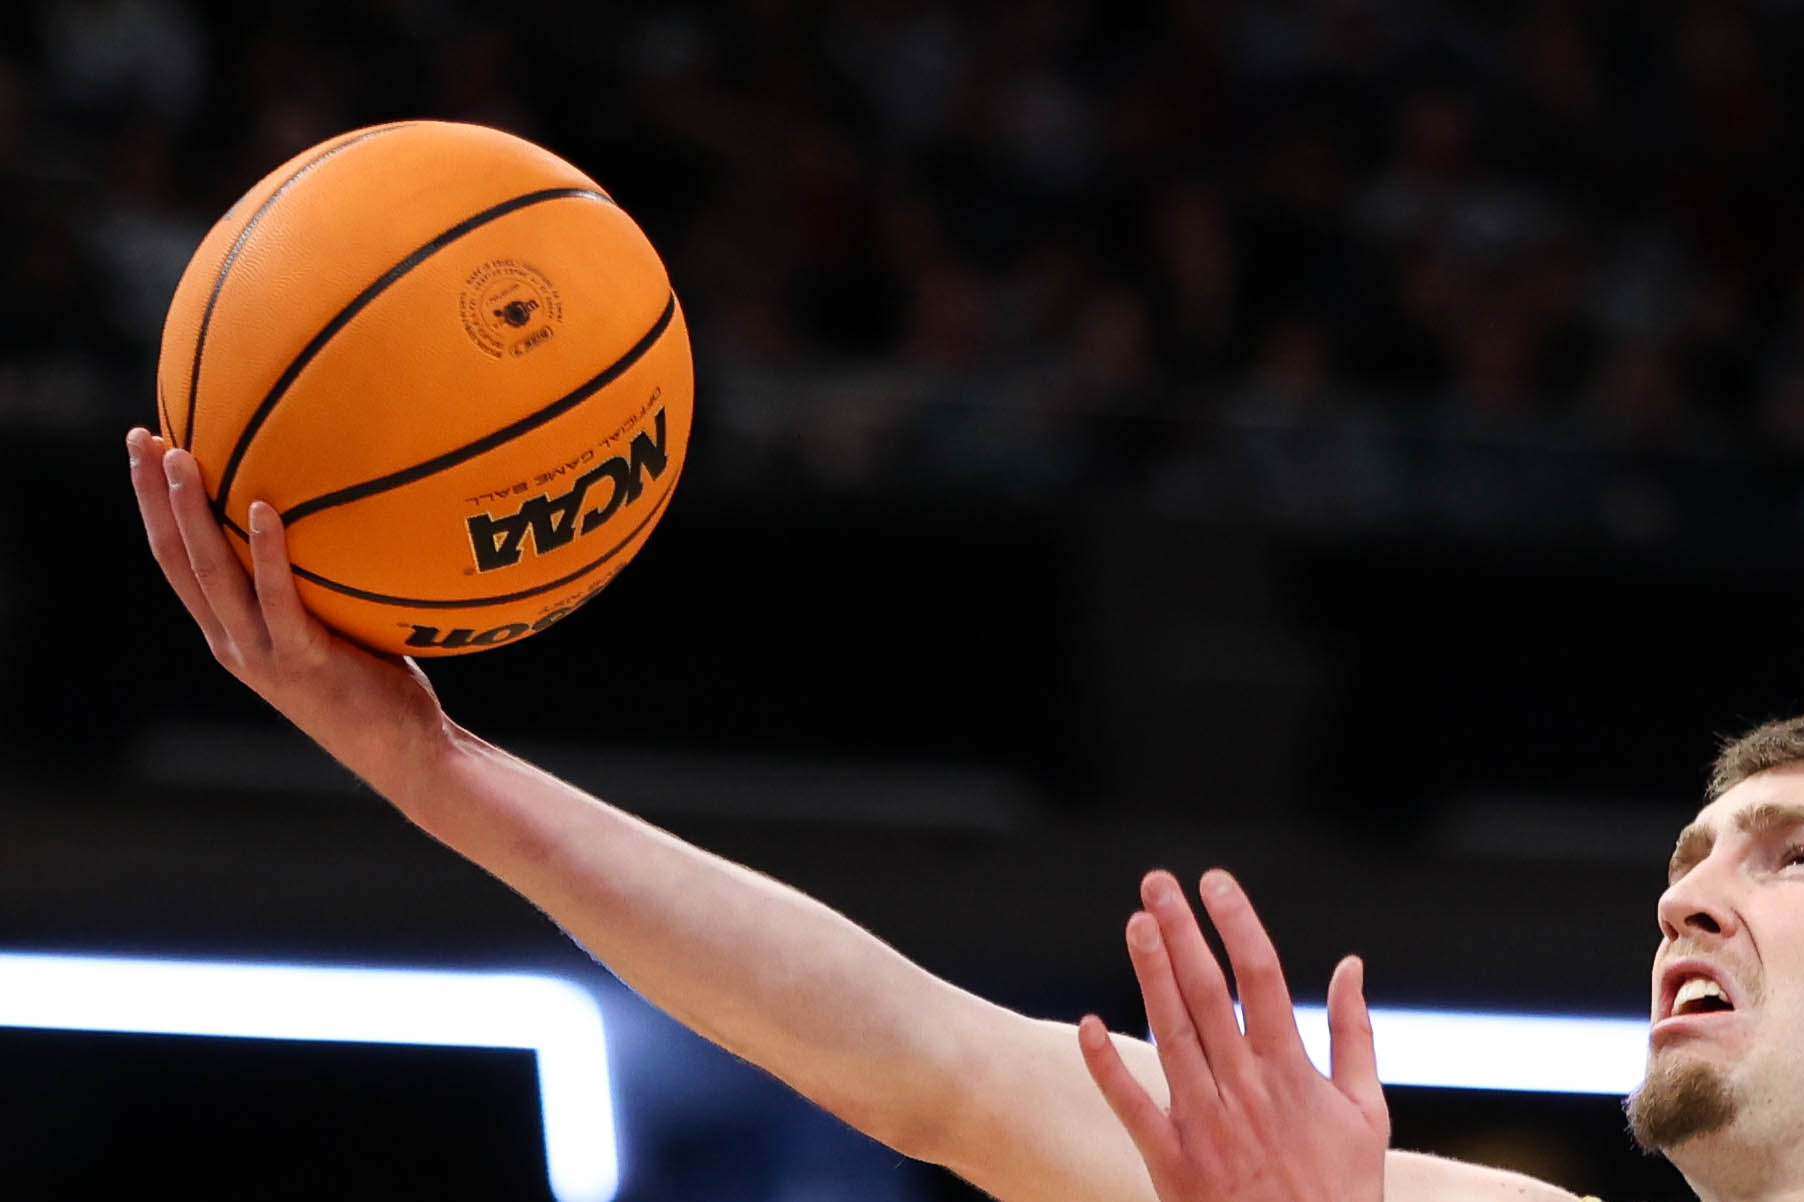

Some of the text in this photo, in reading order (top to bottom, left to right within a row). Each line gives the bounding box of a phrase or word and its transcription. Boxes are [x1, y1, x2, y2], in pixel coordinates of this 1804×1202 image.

[534, 449, 595, 483] GAME
[465, 406, 668, 574] NCAA
[465, 481, 529, 506] BALL
